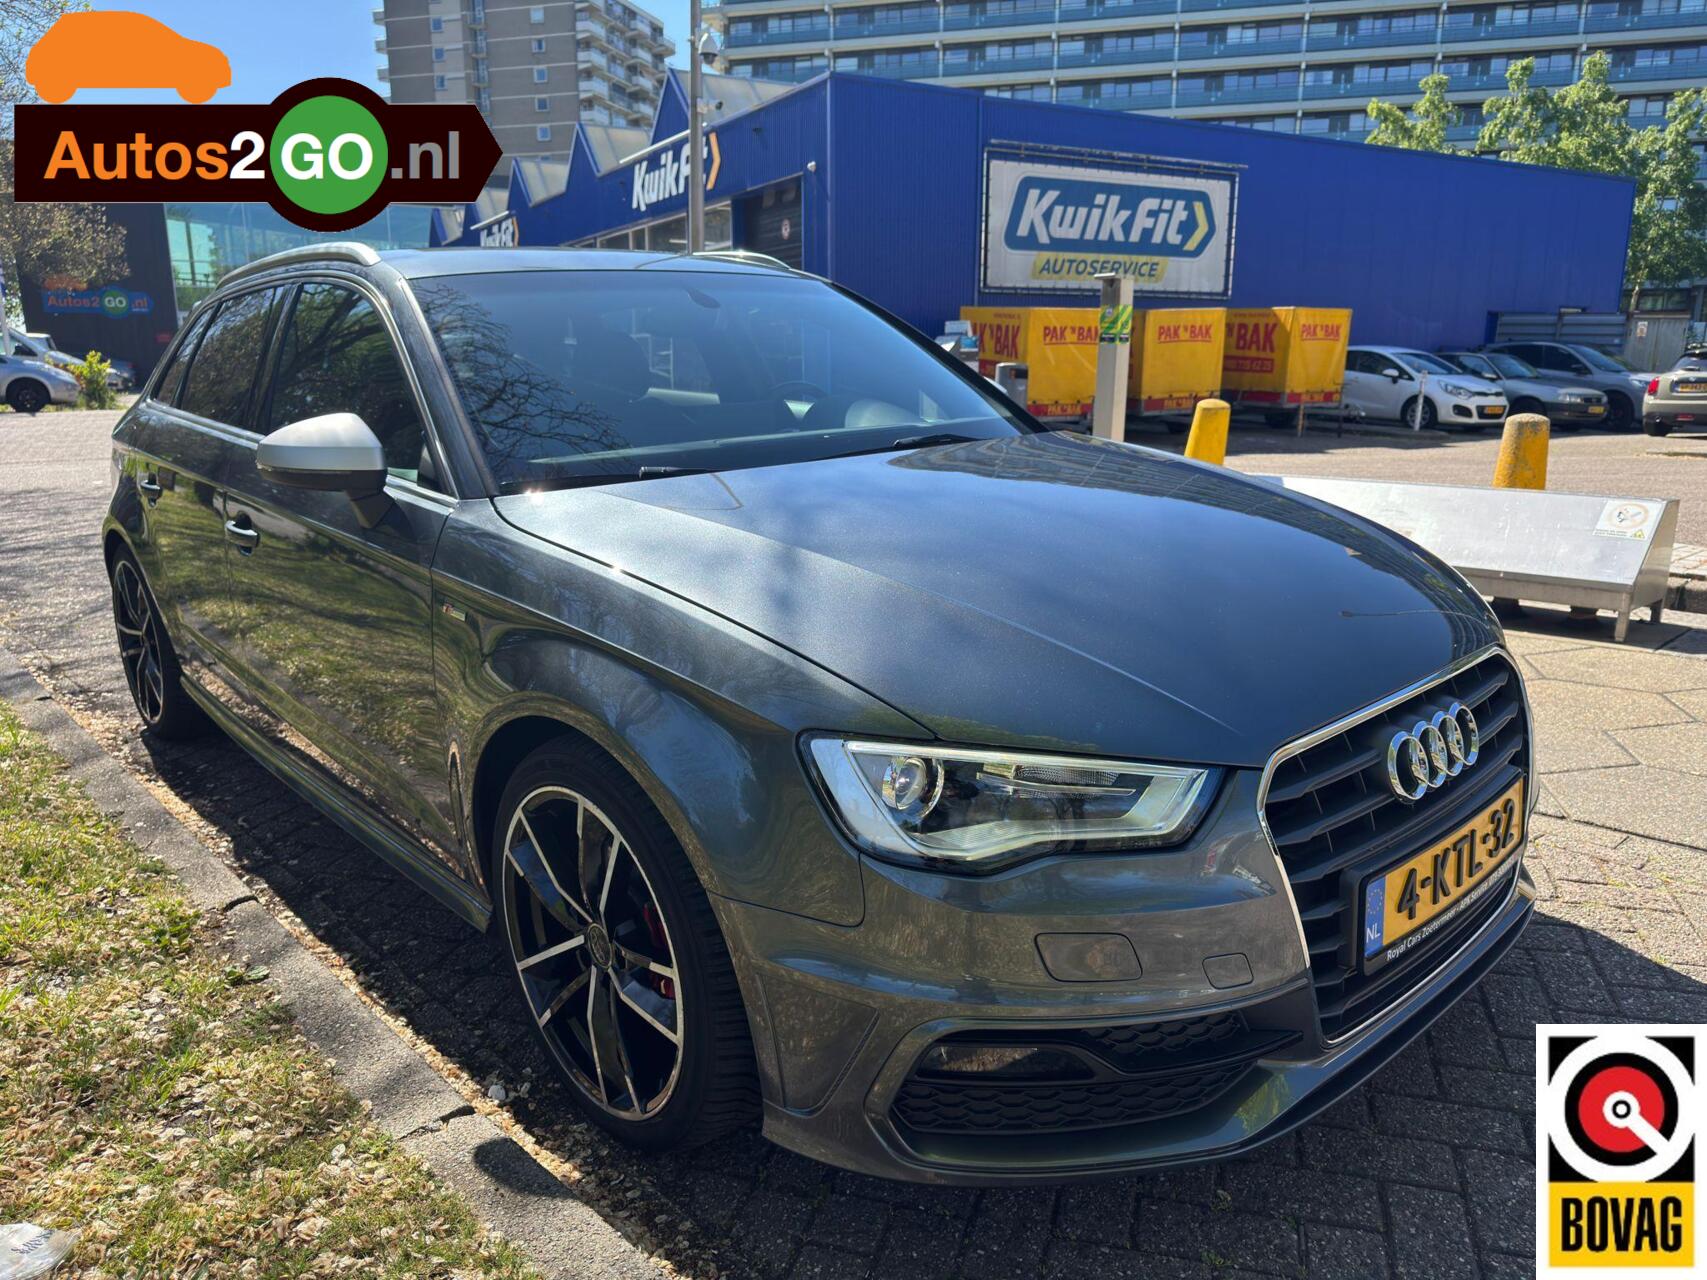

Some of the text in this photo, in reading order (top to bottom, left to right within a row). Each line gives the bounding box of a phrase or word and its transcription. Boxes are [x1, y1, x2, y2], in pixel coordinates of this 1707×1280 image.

[1039, 259, 1160, 277] AUTOSERVICE
[995, 322, 1020, 359] BAK
[1044, 326, 1067, 342] PAK
[1158, 325, 1180, 340] PAK
[1190, 324, 1212, 339] BAK
[1235, 323, 1278, 353] BAK
[1301, 324, 1318, 337] PAK
[1324, 324, 1341, 338] BAK
[1397, 799, 1515, 920] 4-KTL-32
[1366, 924, 1381, 943] NL
[1387, 939, 1406, 961] Royal
[1407, 932, 1421, 948] Cars
